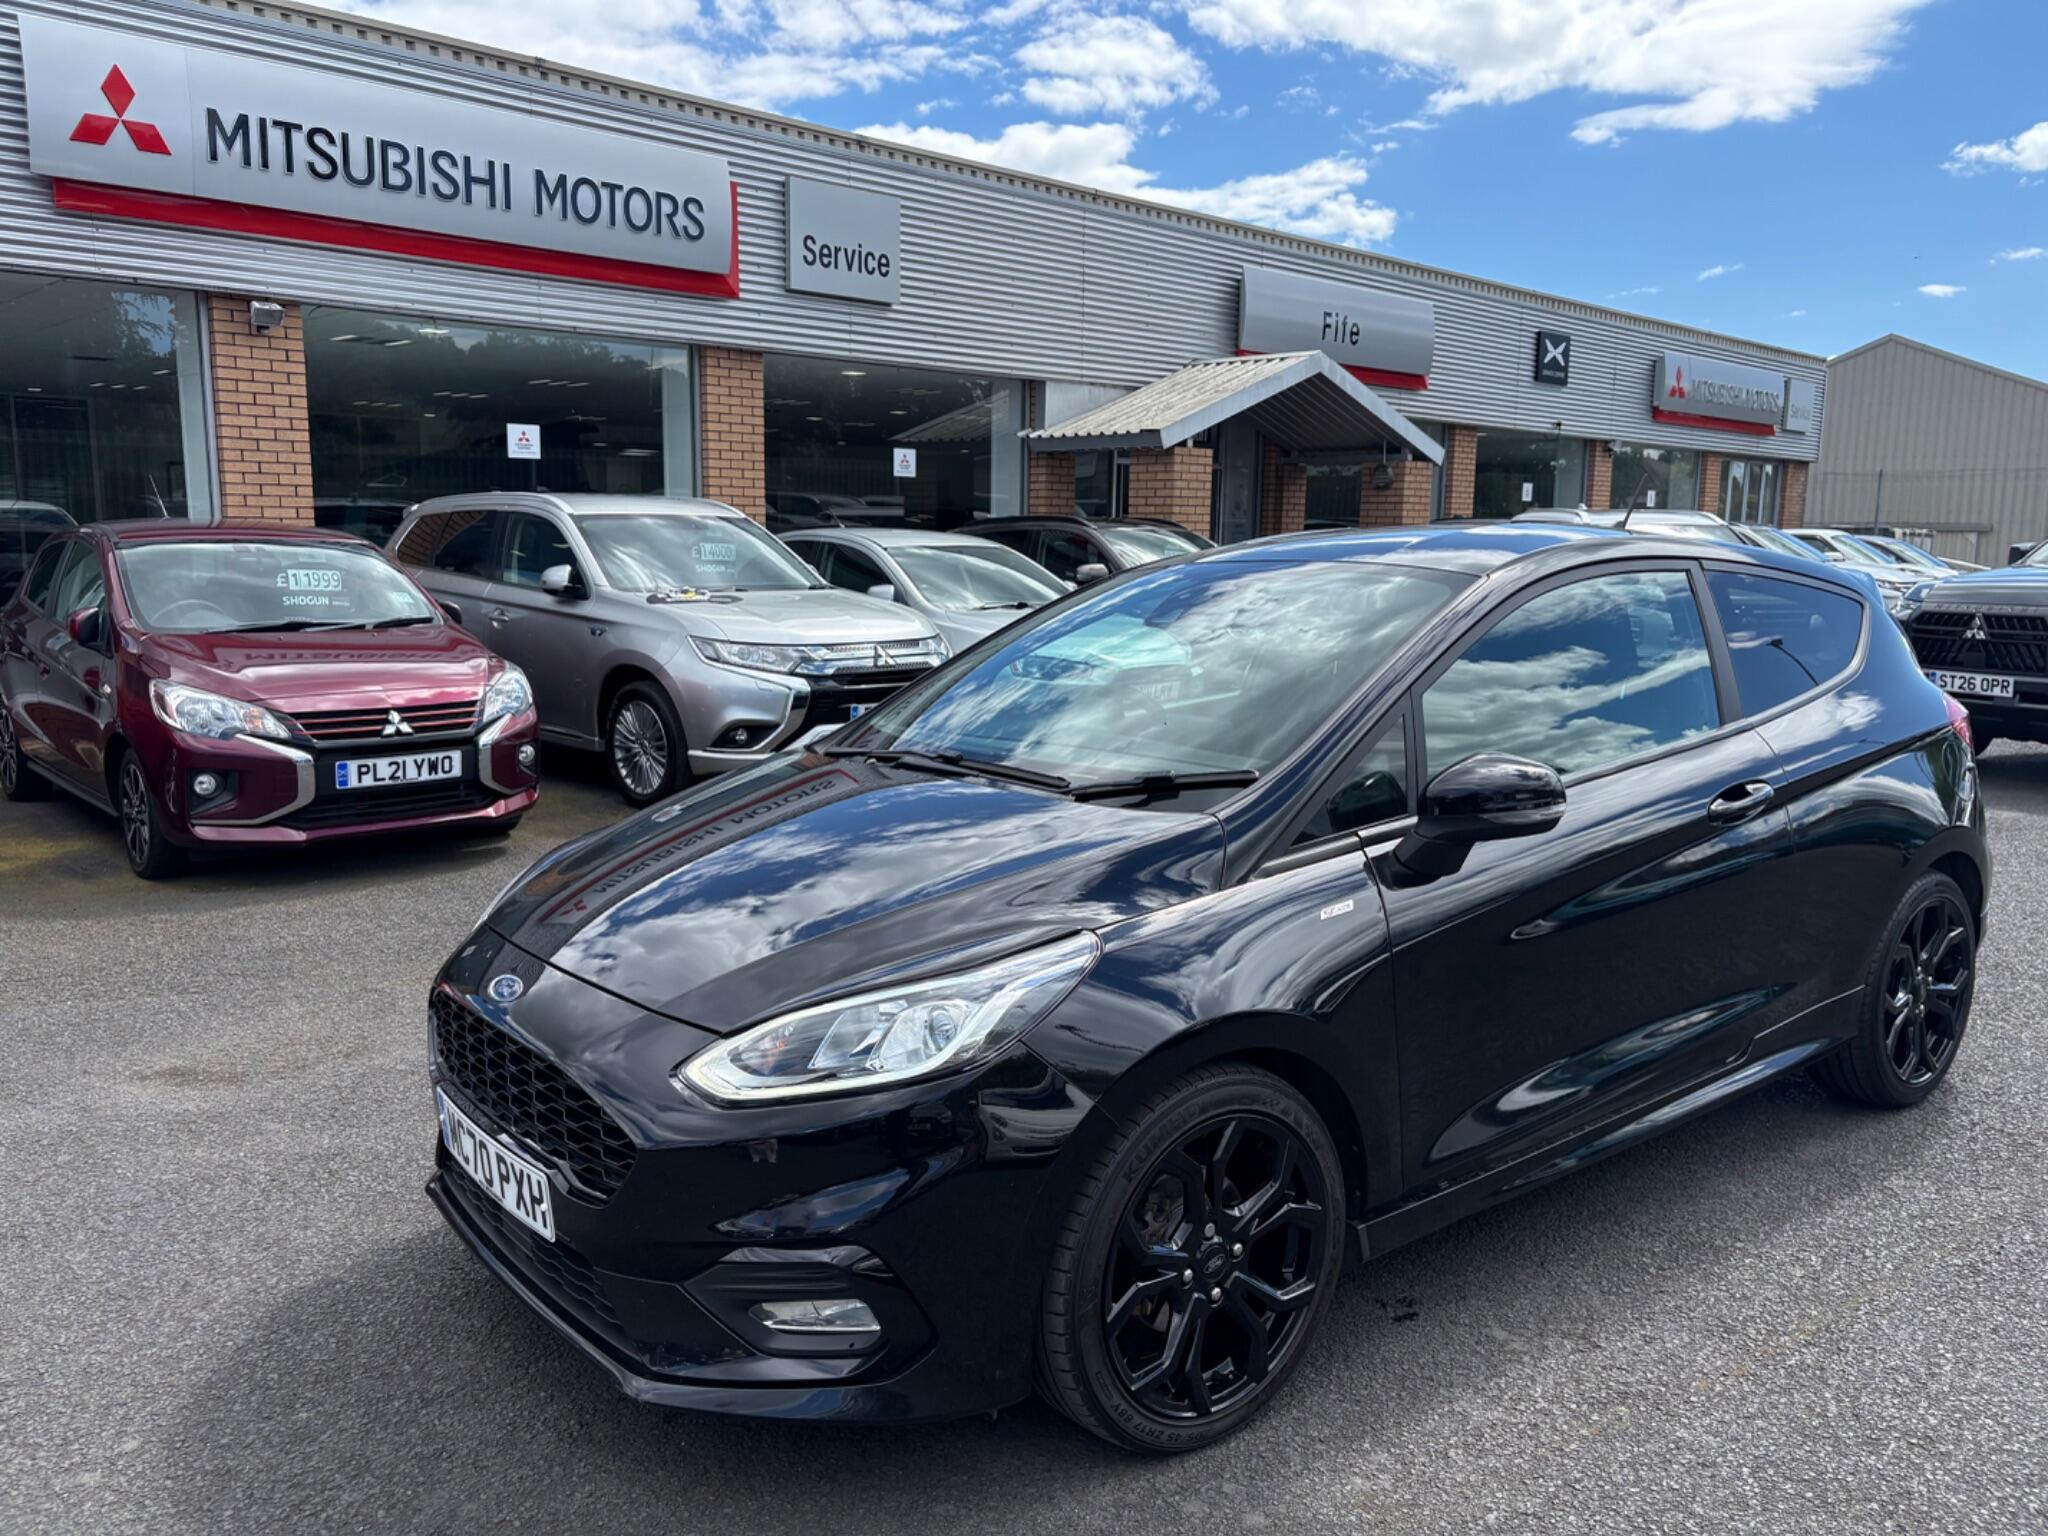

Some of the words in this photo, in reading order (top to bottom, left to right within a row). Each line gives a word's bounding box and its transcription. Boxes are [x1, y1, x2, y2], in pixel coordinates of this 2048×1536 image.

[206, 107, 511, 212] MITSUBISHI
[534, 169, 706, 242] MOTORS
[802, 234, 890, 277] Service
[1322, 311, 1360, 346] Fife
[282, 595, 329, 606] SHOGUN
[1939, 674, 1976, 691] ST26
[1981, 678, 2010, 694] OPR
[357, 760, 406, 783] PL21
[414, 755, 453, 777] YWO
[496, 1151, 548, 1230] PXH
